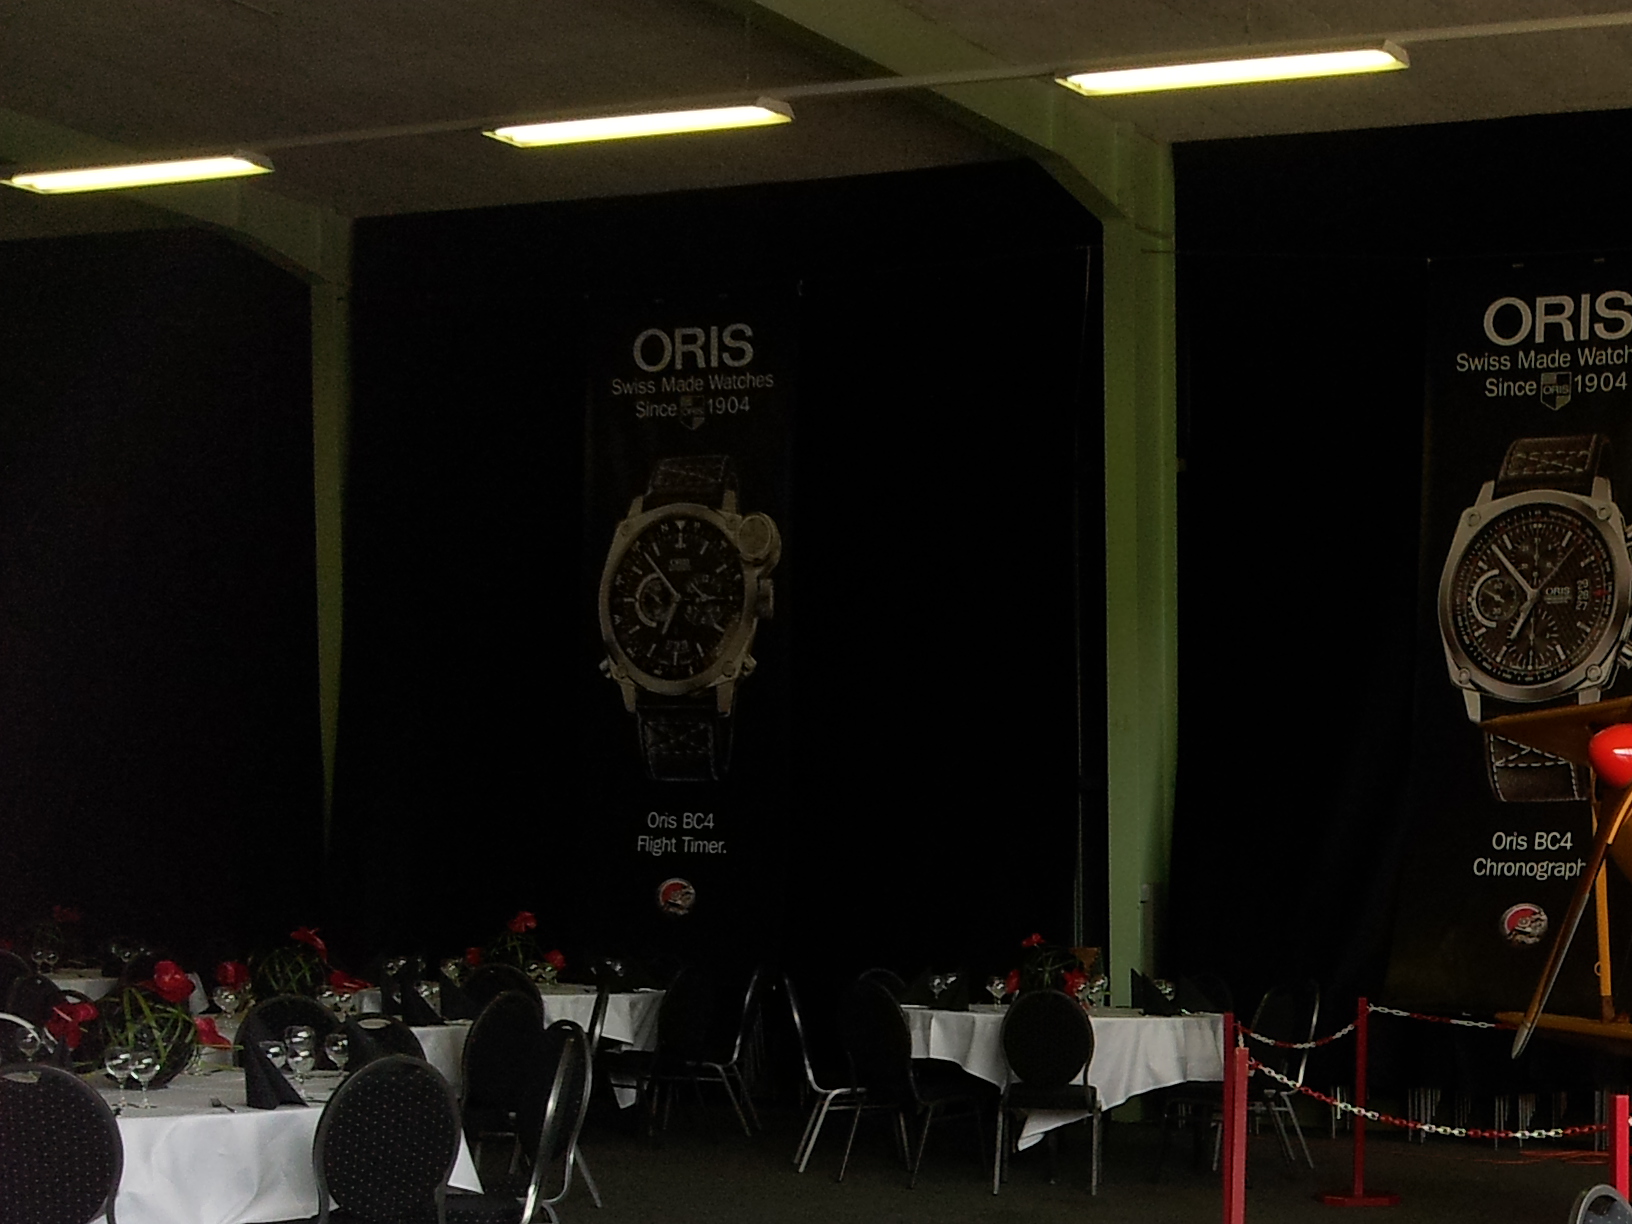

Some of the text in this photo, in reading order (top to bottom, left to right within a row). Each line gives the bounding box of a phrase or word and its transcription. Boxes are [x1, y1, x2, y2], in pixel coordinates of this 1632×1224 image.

[632, 322, 755, 374] ORIS
[1456, 352, 1511, 372] Swiss
[1517, 349, 1571, 370] Made
[611, 371, 775, 396] Swiss Made Watches
[1484, 371, 1628, 398] Since 1904
[1543, 384, 1570, 396] ORIS
[635, 400, 678, 419] Since
[707, 395, 750, 415] 1904
[647, 811, 715, 830] Oris BC4
[637, 834, 728, 857] Flight Timer.
[1491, 831, 1573, 851] Oris BC4
